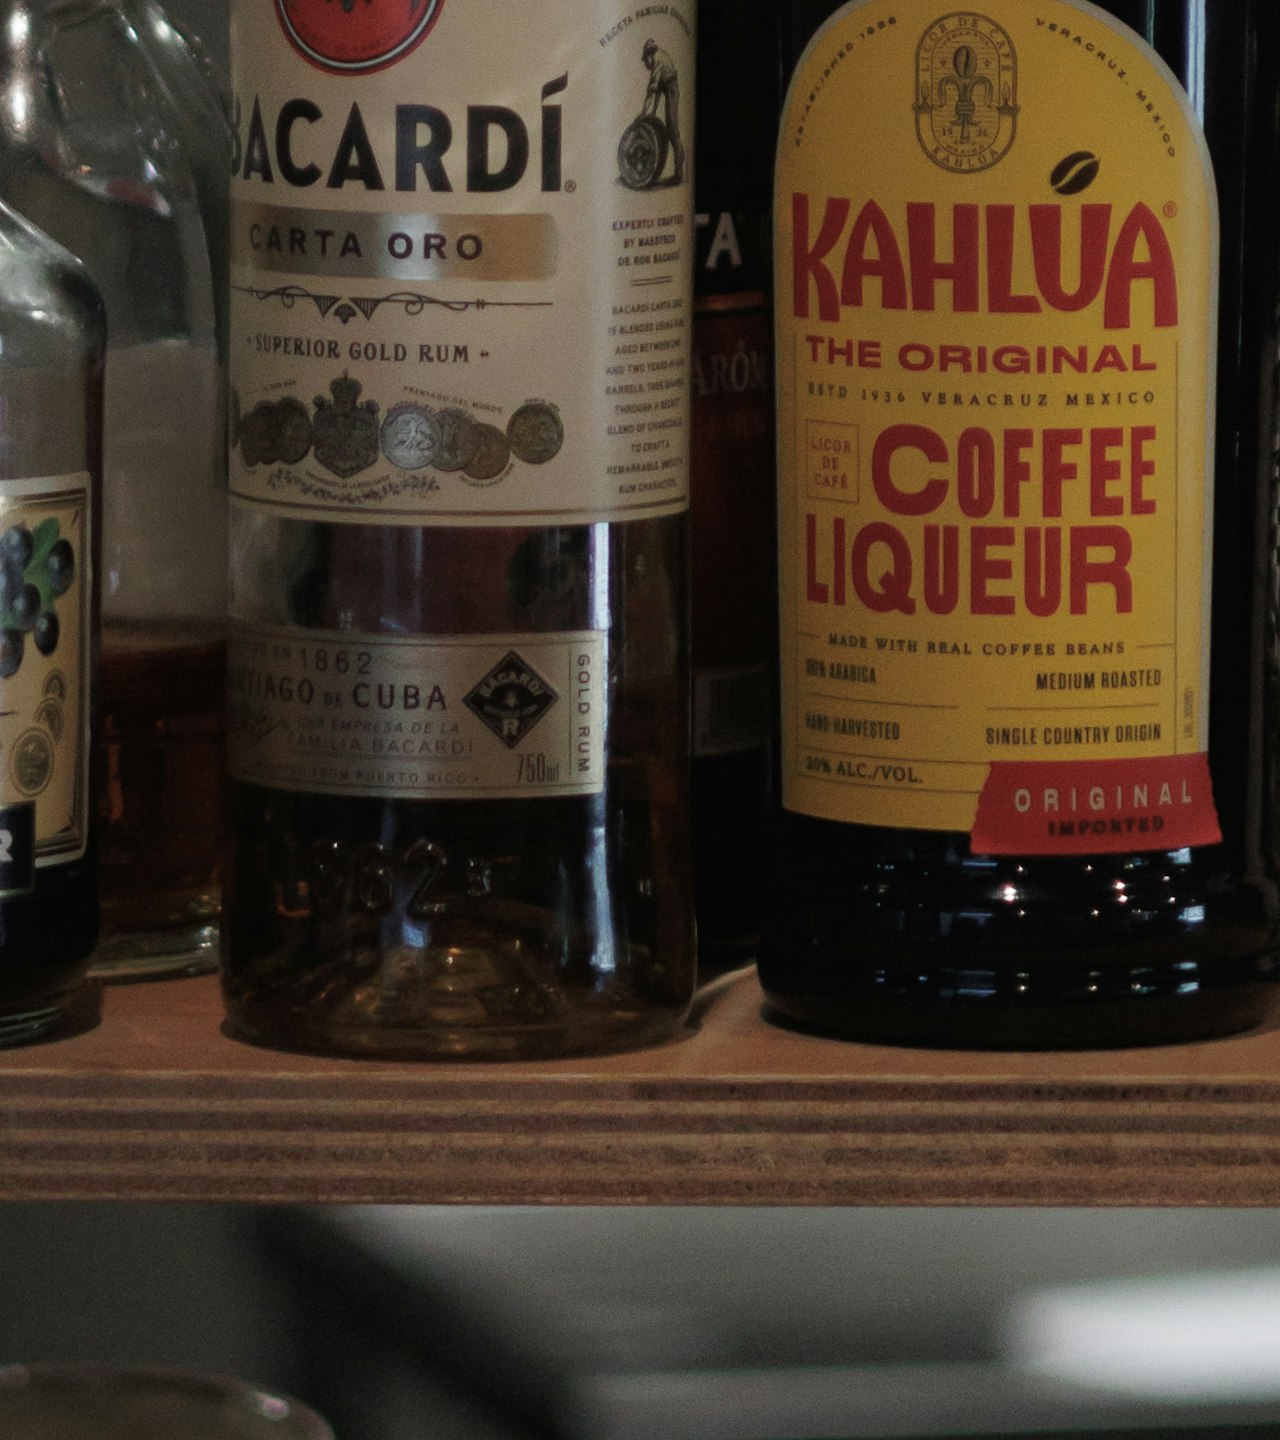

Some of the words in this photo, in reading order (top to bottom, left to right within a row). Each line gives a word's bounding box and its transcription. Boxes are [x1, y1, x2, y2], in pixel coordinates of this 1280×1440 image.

[249, 223, 362, 260] CARTA
[386, 232, 485, 262] ORO
[254, 335, 341, 362] SUPERIOR
[348, 336, 409, 364] GOLD
[418, 342, 471, 365] RUM
[805, 334, 883, 369] THE
[898, 342, 1158, 375] ORIGINAL
[861, 388, 907, 404] 1936
[921, 391, 1049, 407] VERACRUZ
[1065, 389, 1156, 406] MEXICO
[811, 436, 853, 454] LICOR
[822, 455, 841, 472] DE
[871, 423, 1158, 519] COFFEE
[805, 512, 1134, 618] LIQUEUR
[827, 631, 868, 650] MADE
[875, 636, 919, 654] WITH
[926, 639, 973, 656] REAL
[981, 642, 1056, 657] COFFEE
[1065, 640, 1126, 657] BEANS
[300, 648, 373, 675] 1862
[828, 661, 877, 685] ARABICA
[576, 653, 591, 717] GOLD
[1035, 671, 1096, 691] MEDIUM
[1101, 668, 1162, 689] ROASTED
[352, 682, 448, 713] CUBA
[410, 722, 432, 735] DE
[441, 722, 460, 735] LA
[985, 726, 1038, 747] SINGLE
[1043, 725, 1111, 746] COUNTRY
[1114, 723, 1162, 744] ORIGIN
[371, 737, 474, 756] BACARDÍ
[576, 726, 591, 774] RUM
[355, 770, 420, 784] PUERTO
[427, 772, 469, 784] RICO
[1014, 779, 1194, 814] ORIGINAL
[1047, 814, 1166, 838] IMPORTED
